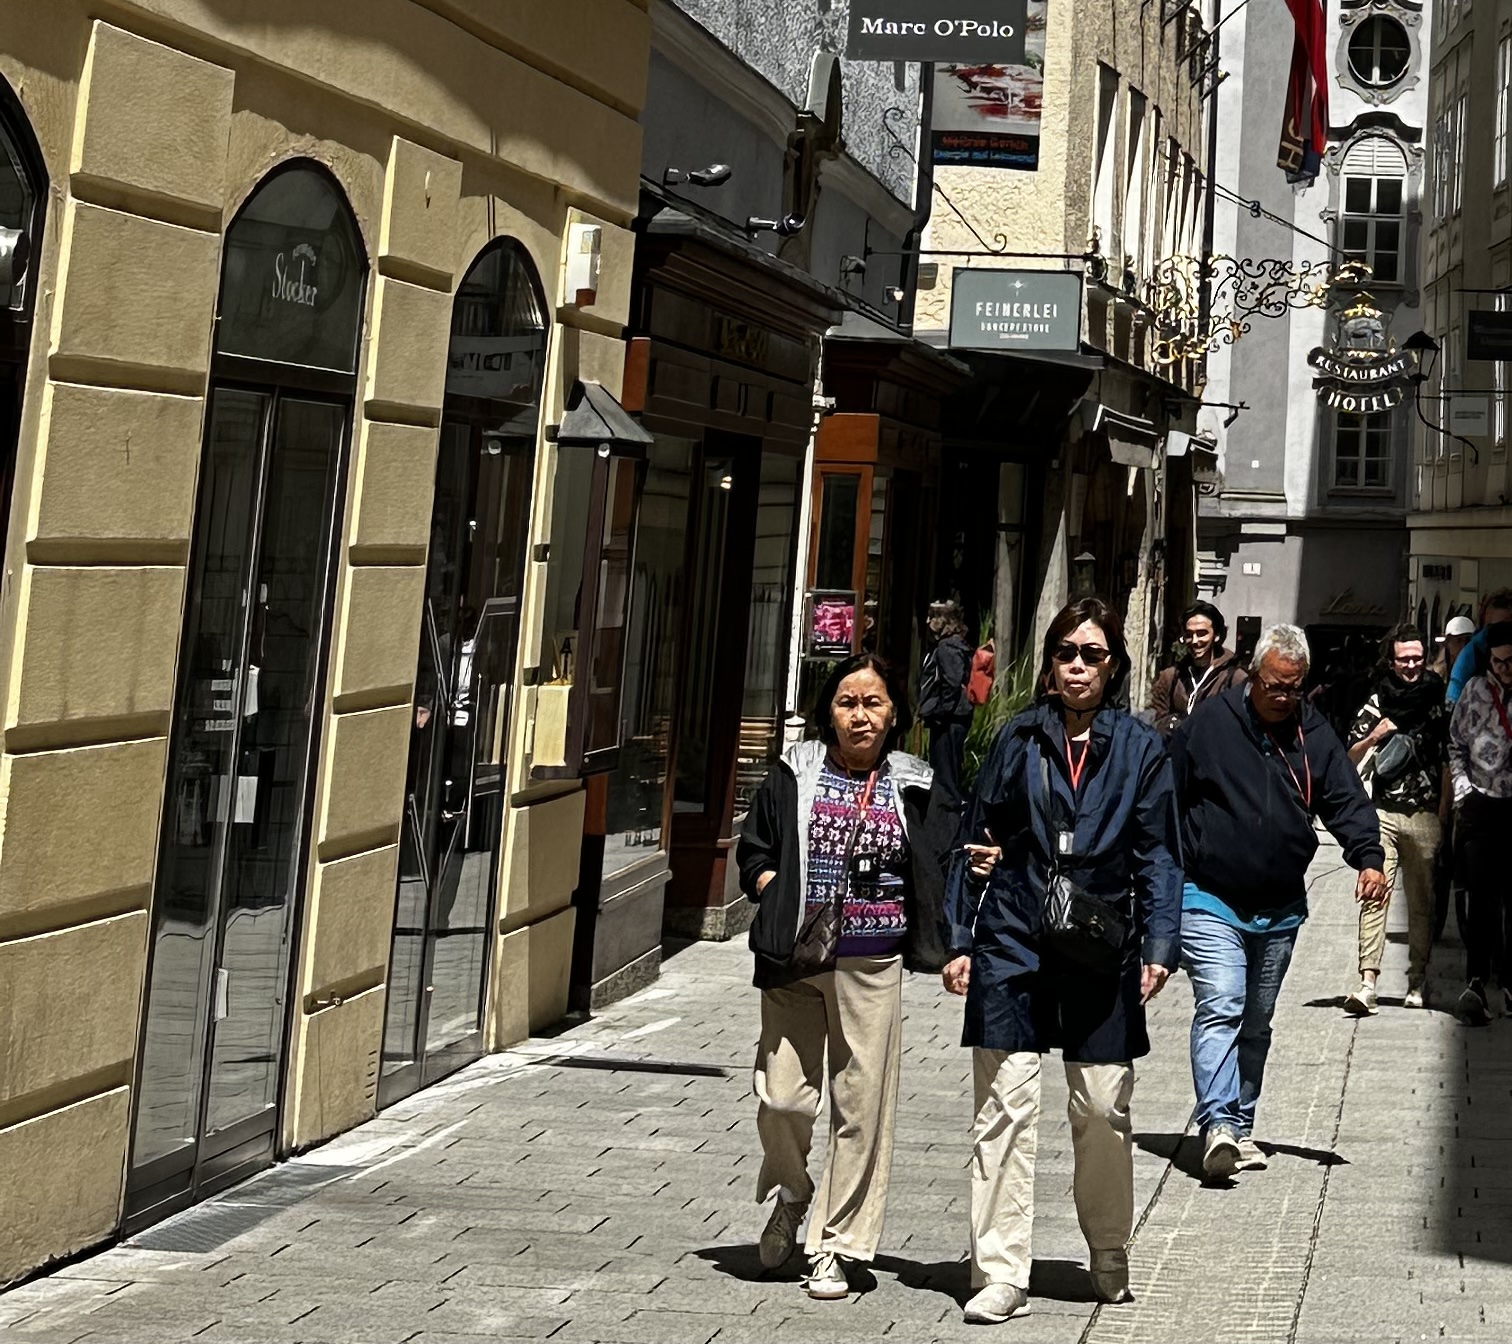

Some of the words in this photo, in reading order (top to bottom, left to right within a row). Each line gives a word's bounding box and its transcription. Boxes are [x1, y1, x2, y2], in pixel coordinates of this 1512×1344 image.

[860, 17, 926, 35] Marc
[933, 19, 1015, 38] O'Polo
[975, 301, 1058, 319] FEINERLEI
[1315, 355, 1405, 381] RESTAURANT
[1327, 392, 1396, 412] HOTEL
